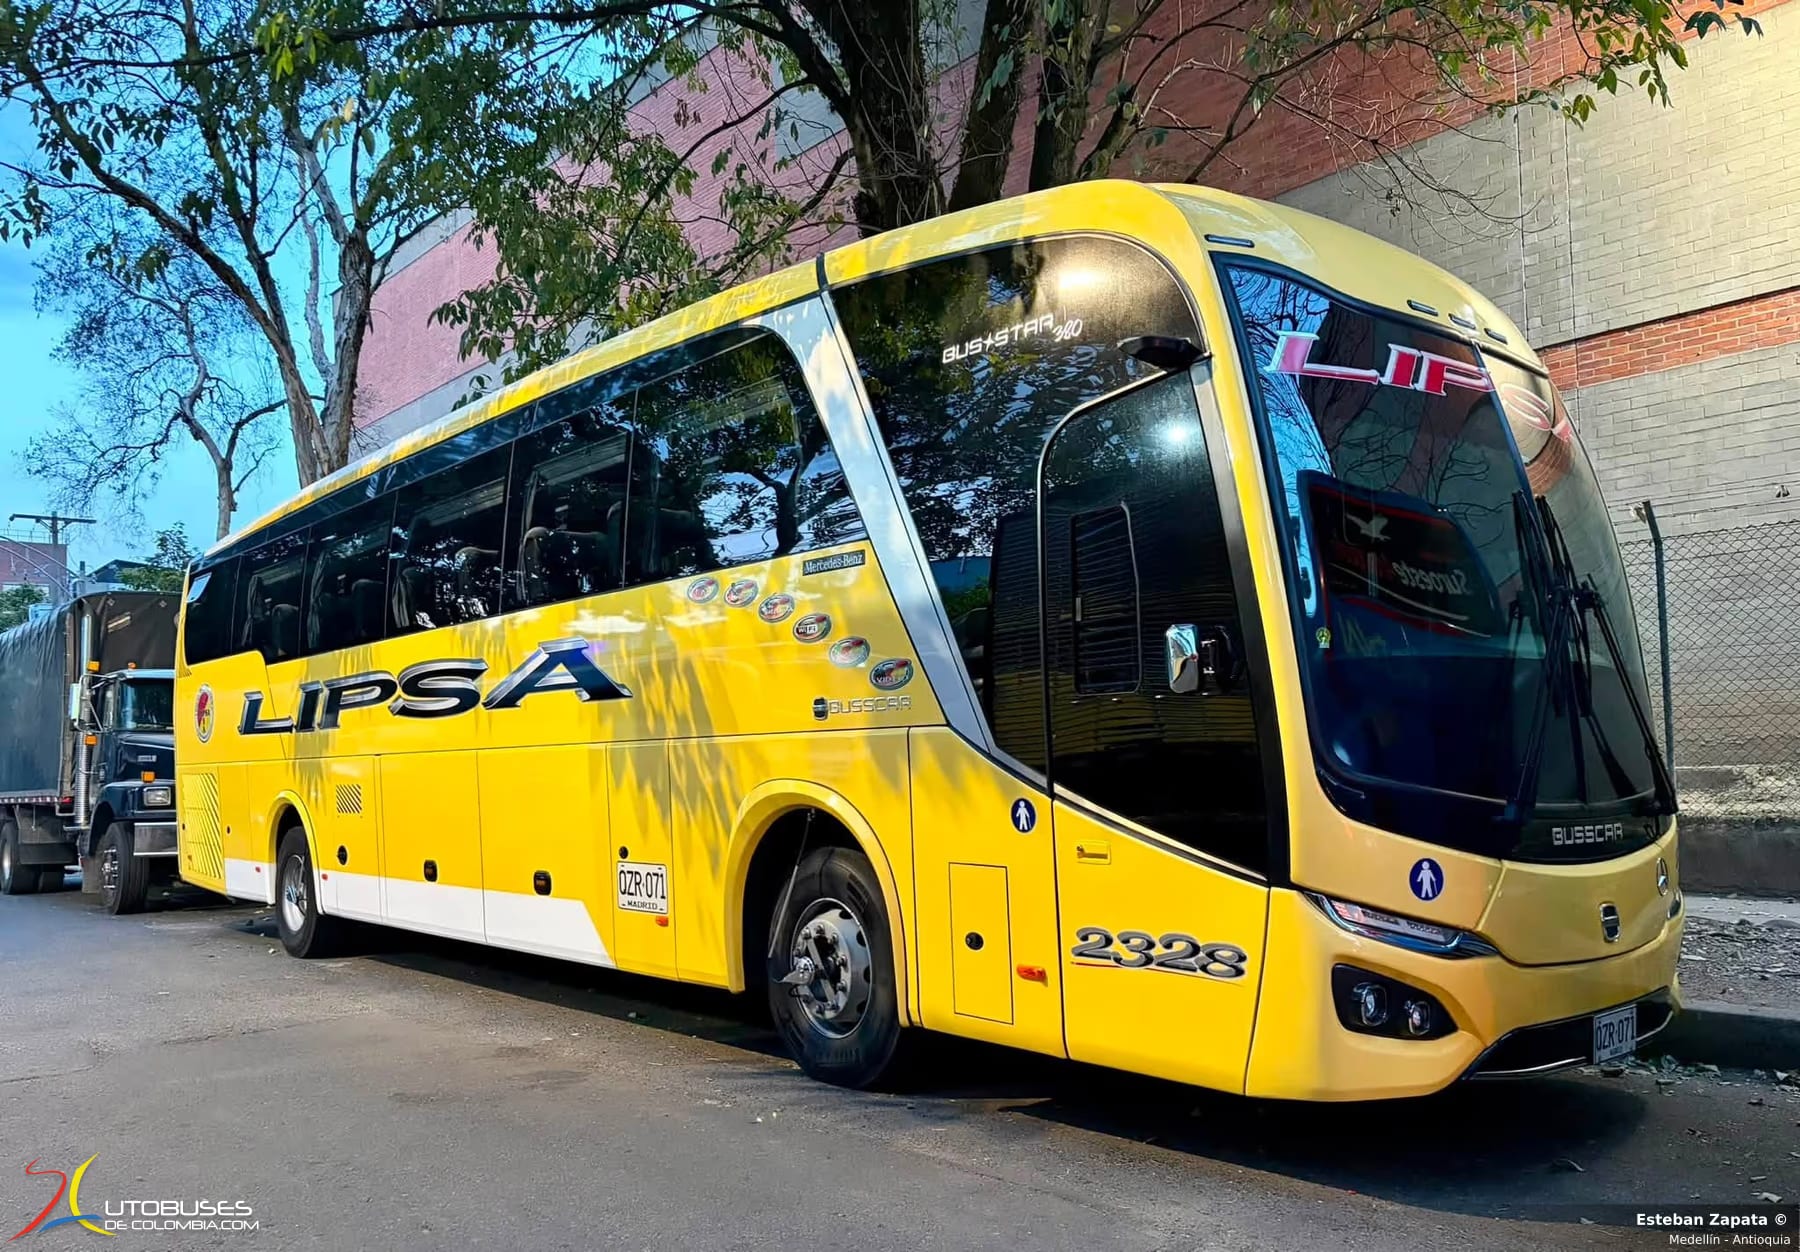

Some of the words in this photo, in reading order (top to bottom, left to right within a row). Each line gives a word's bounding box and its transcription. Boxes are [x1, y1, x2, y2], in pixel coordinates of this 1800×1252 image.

[1052, 318, 1083, 342] 380
[804, 554, 863, 574] Mercedes-Benz
[237, 636, 633, 735] LIPSA
[829, 696, 911, 714] BUSSCAR
[1552, 822, 1623, 846] BUSSCAR
[627, 900, 658, 910] MADRID
[1072, 927, 1248, 979] 2328
